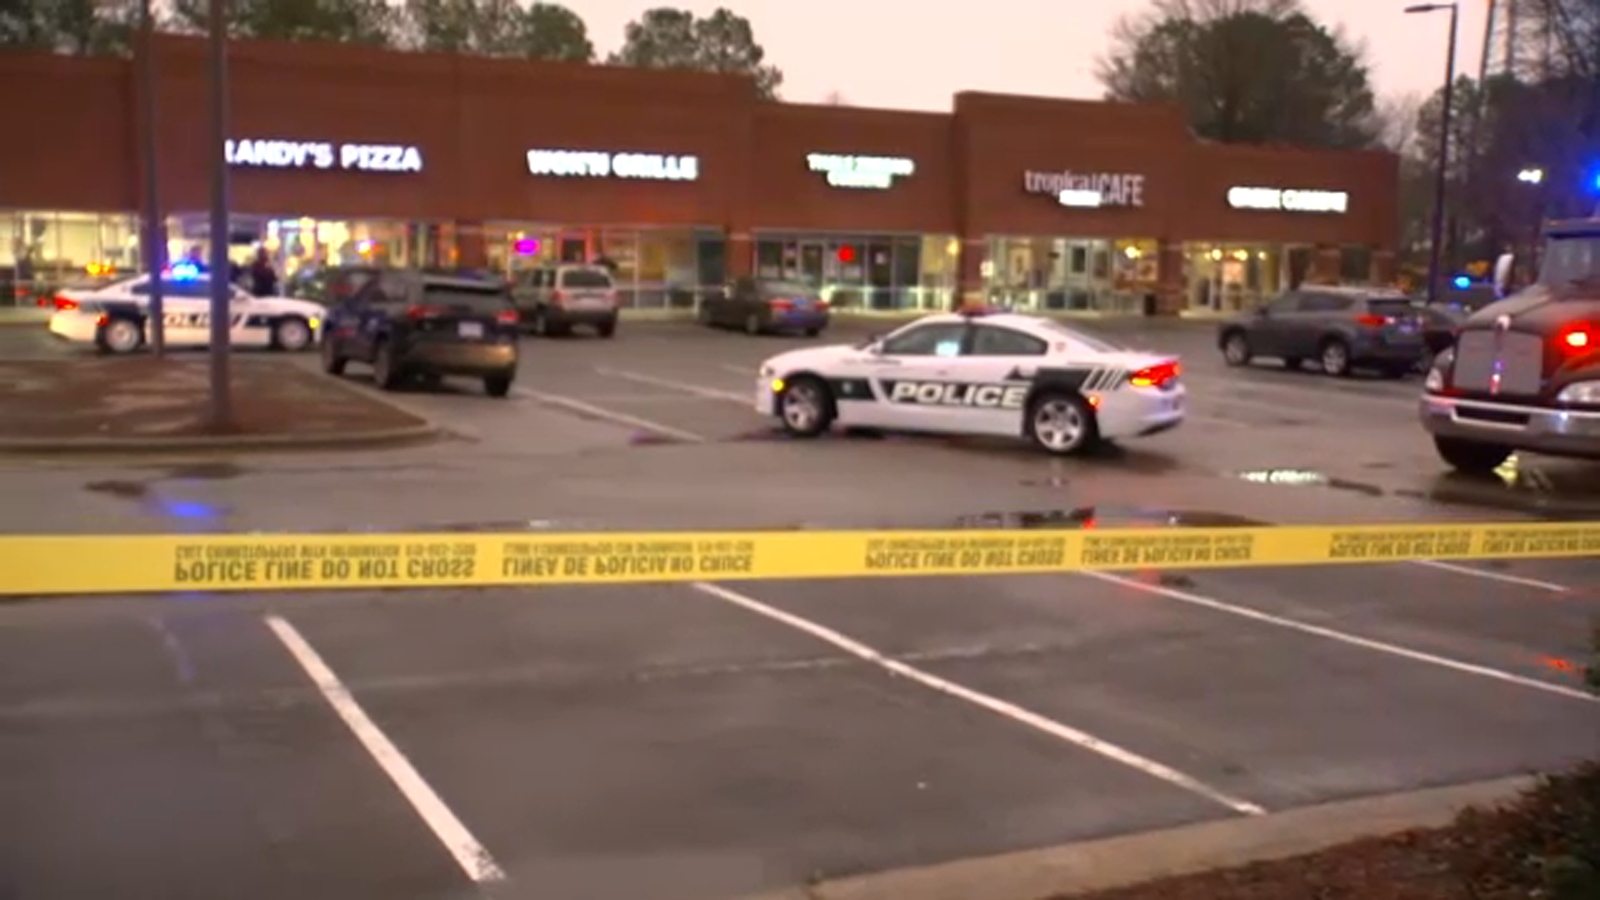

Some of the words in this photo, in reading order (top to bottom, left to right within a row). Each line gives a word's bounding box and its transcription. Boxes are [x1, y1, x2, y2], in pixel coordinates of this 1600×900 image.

[341, 144, 421, 171] PIZZA
[1099, 172, 1145, 206] CAFE
[891, 381, 1028, 408] POLICE
